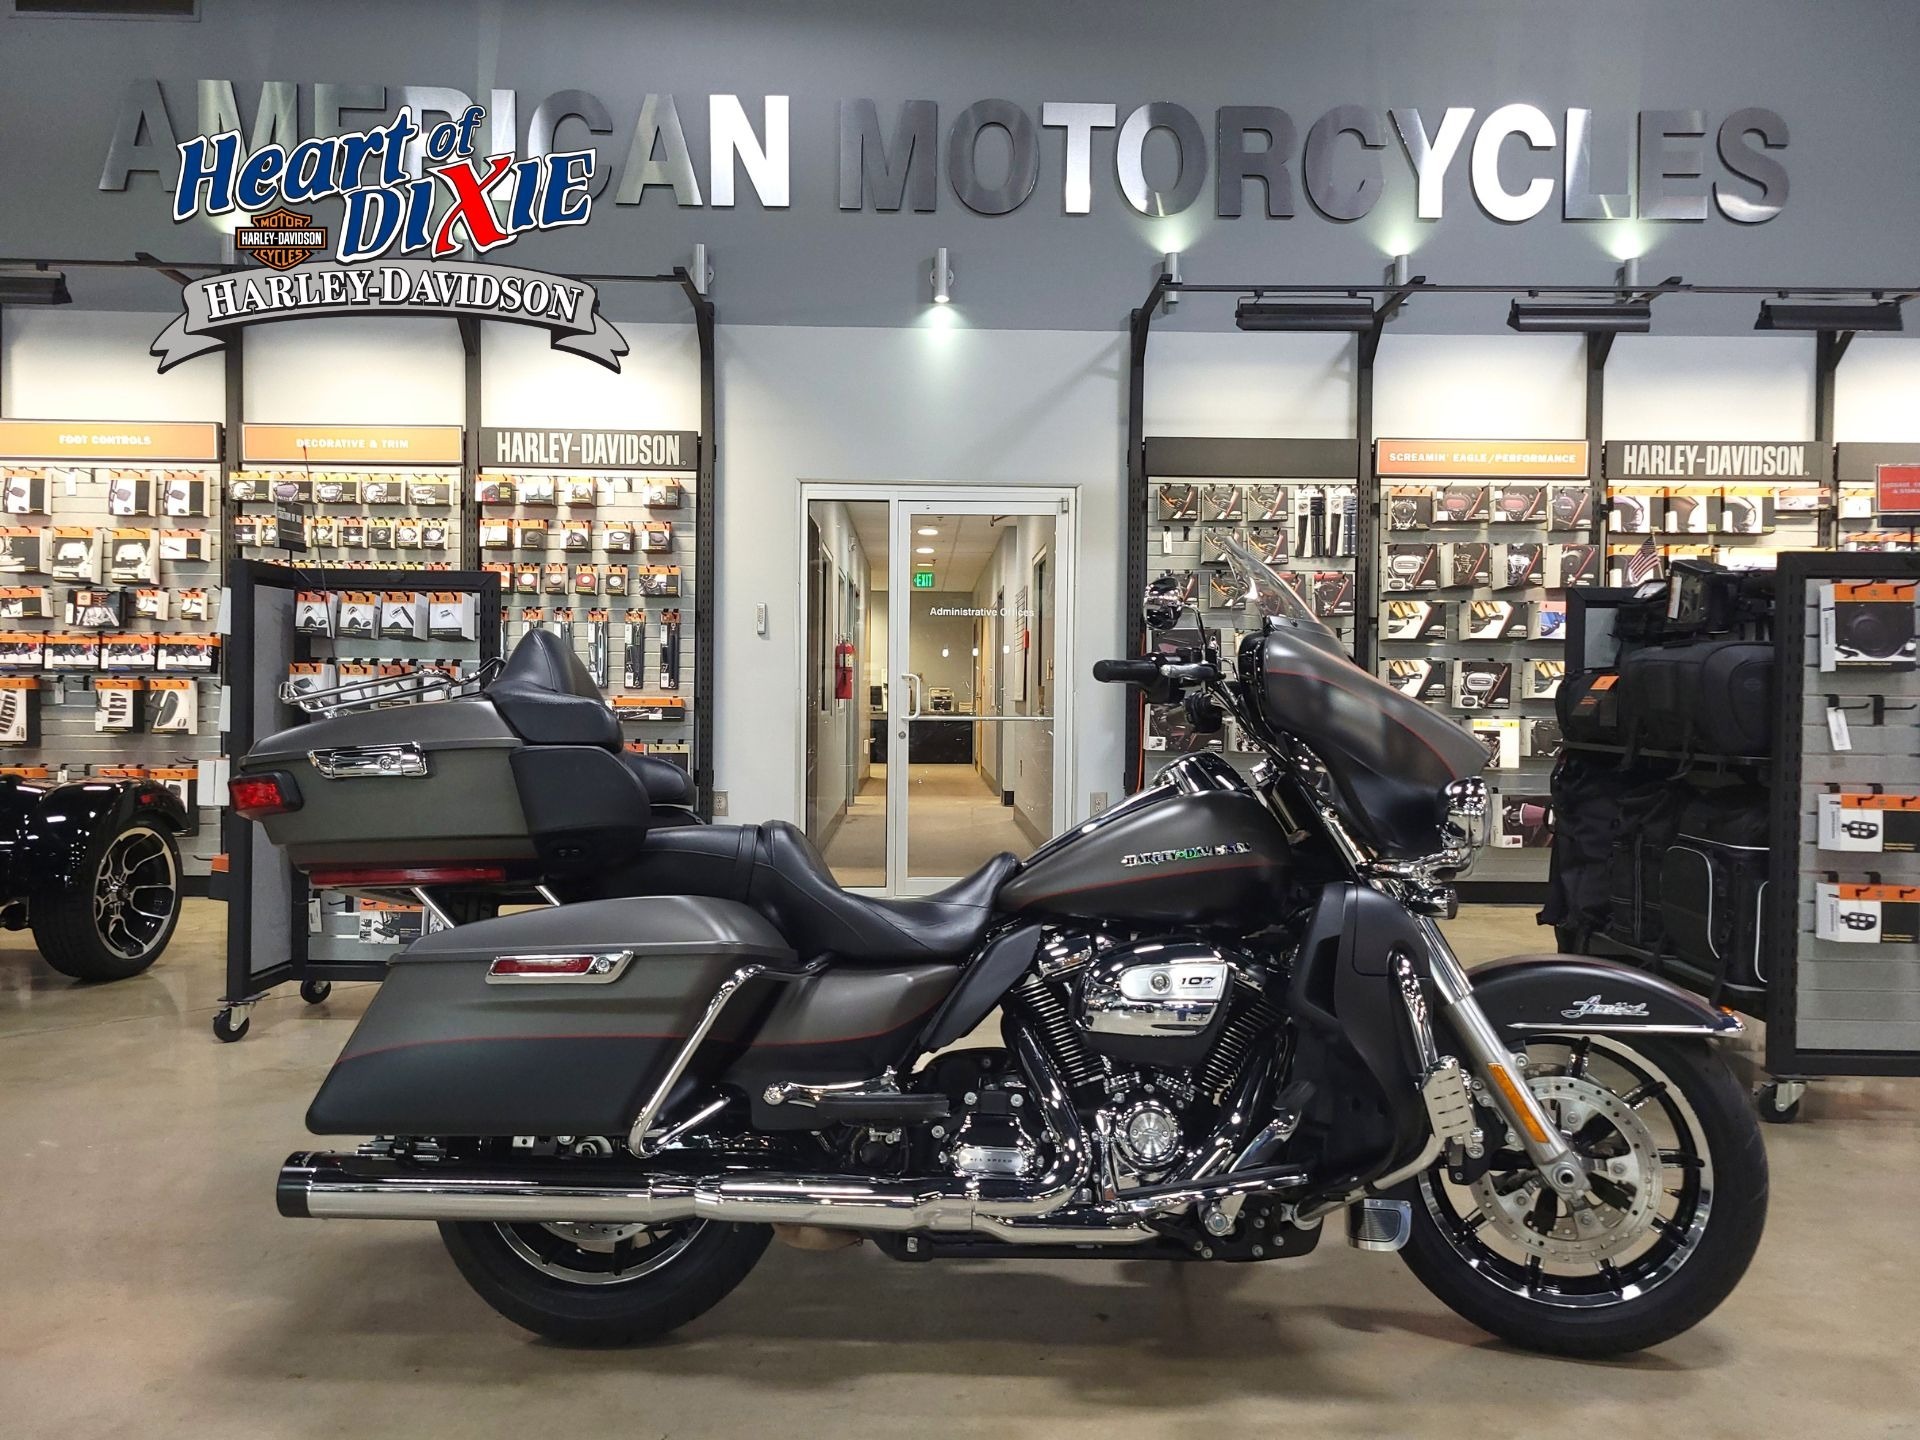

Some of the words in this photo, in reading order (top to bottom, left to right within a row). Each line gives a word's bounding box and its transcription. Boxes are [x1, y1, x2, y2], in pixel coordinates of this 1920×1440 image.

[838, 97, 1790, 225] MOTORCYCLES
[59, 434, 88, 445] FOOT
[91, 435, 152, 446] CONTROLS
[295, 438, 365, 449] DECORATIVE
[381, 439, 409, 449] TRIM
[496, 431, 681, 466] HARLEY-DAVIDSON
[1389, 453, 1450, 463] SCREAMIN'
[1623, 444, 1806, 476] HARLEY-DAVIDSON
[916, 573, 933, 587] EXIT
[929, 607, 998, 617] Administrative
[1181, 976, 1216, 986] 107
